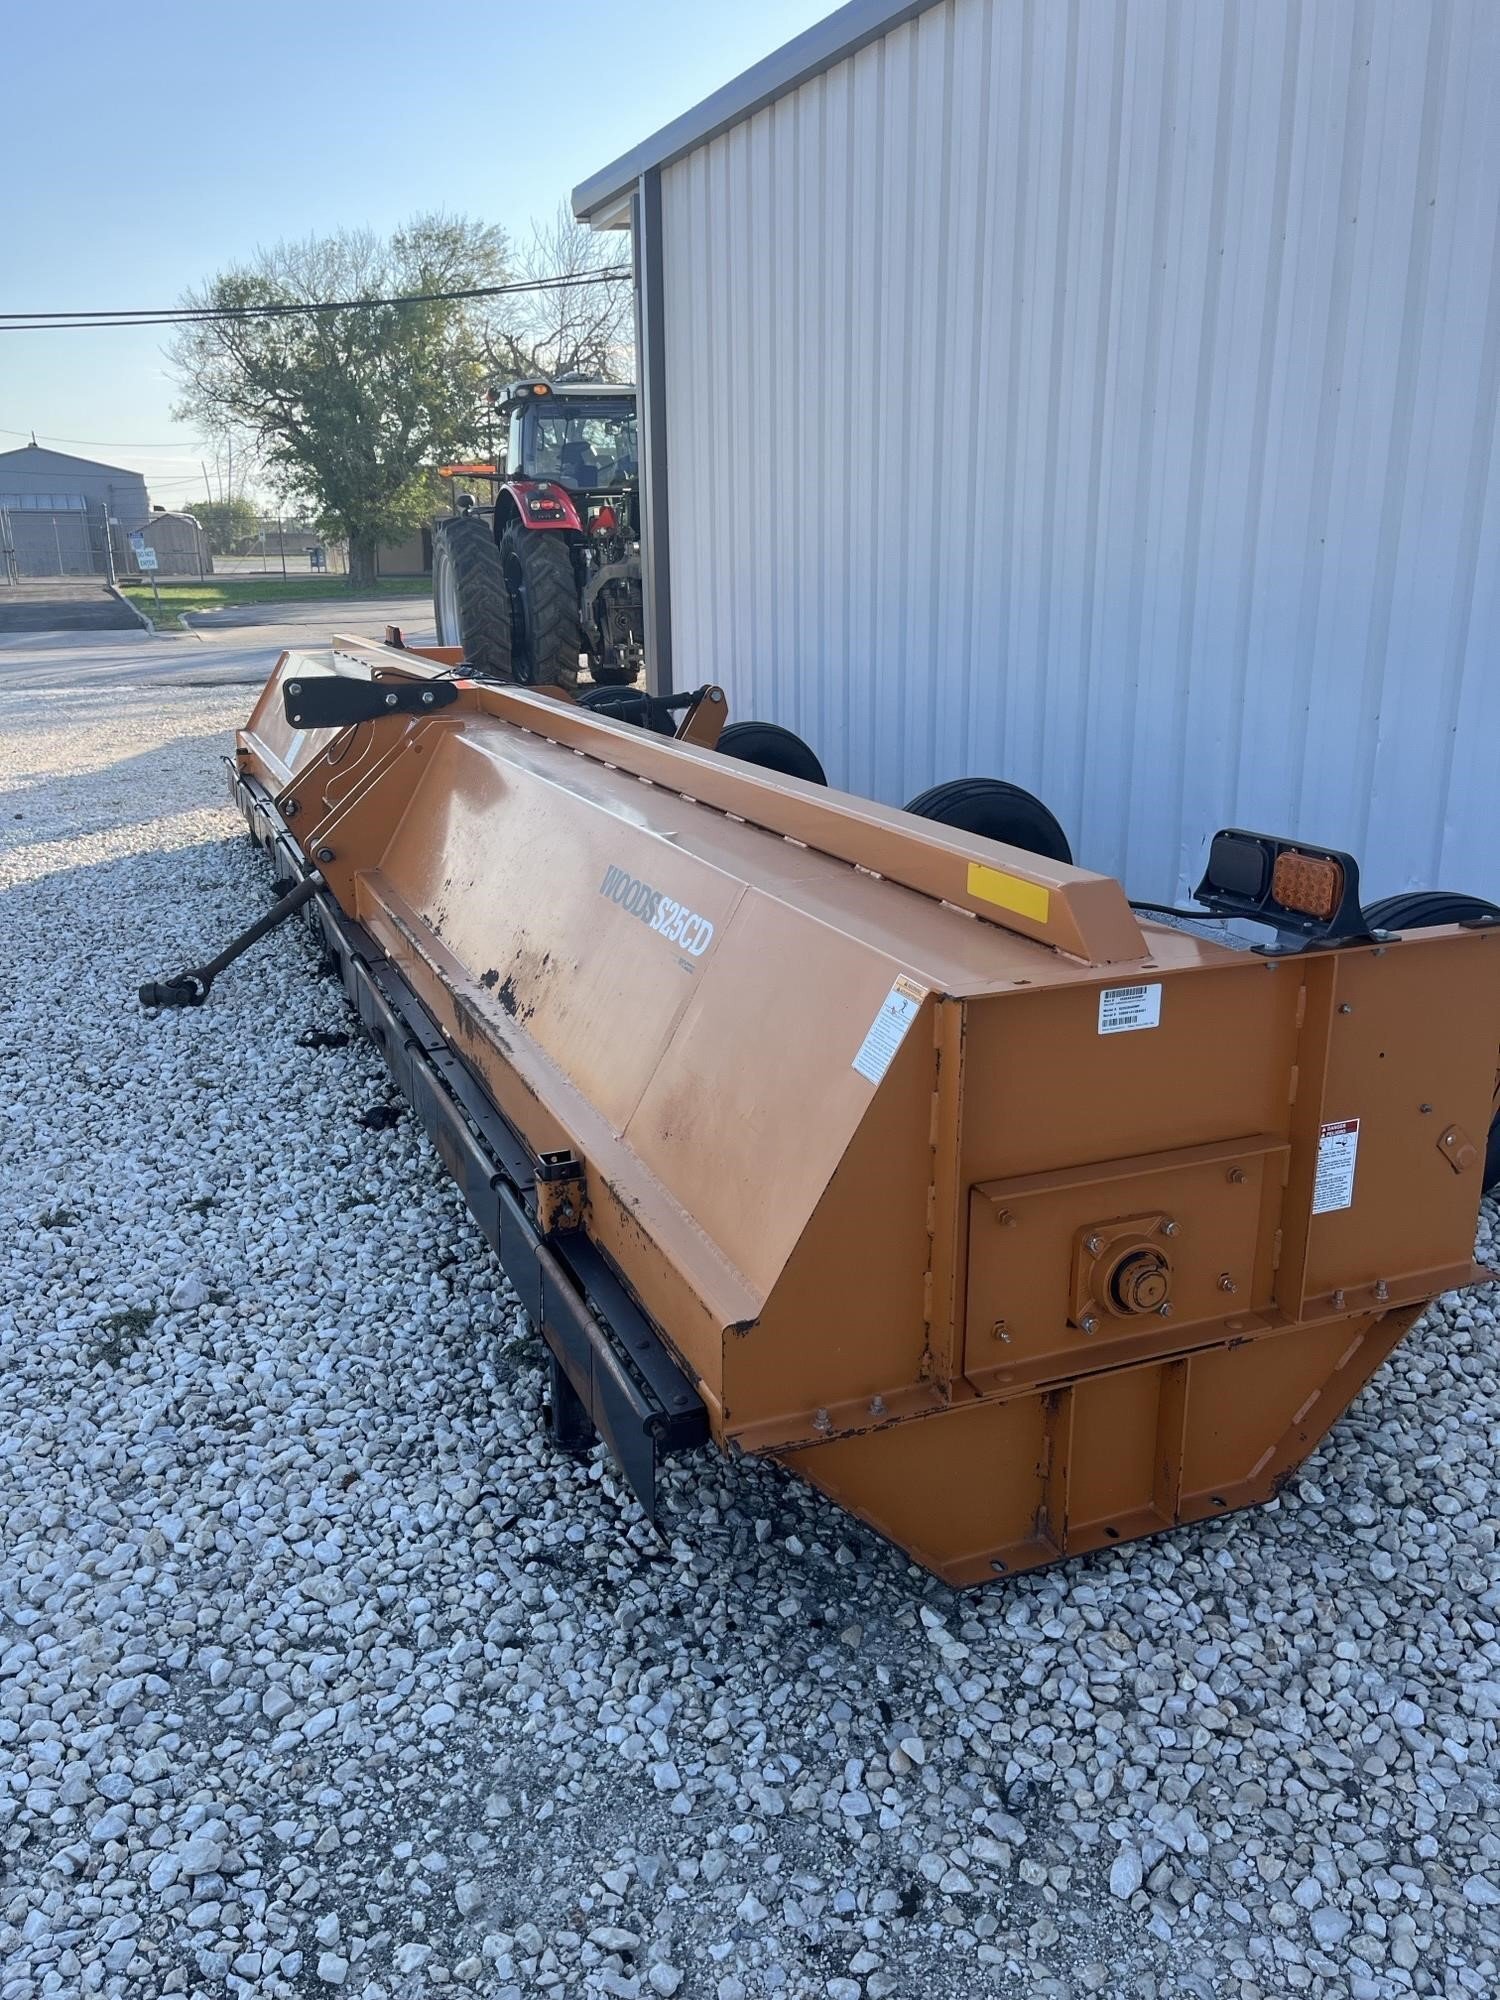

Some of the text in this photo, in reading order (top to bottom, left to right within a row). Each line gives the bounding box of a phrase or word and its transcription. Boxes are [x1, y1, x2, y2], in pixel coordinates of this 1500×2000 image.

[599, 864, 714, 957] WOODS S25CD
[1326, 1123, 1346, 1132] DANGER
[1326, 1129, 1346, 1137] PELIGRO
